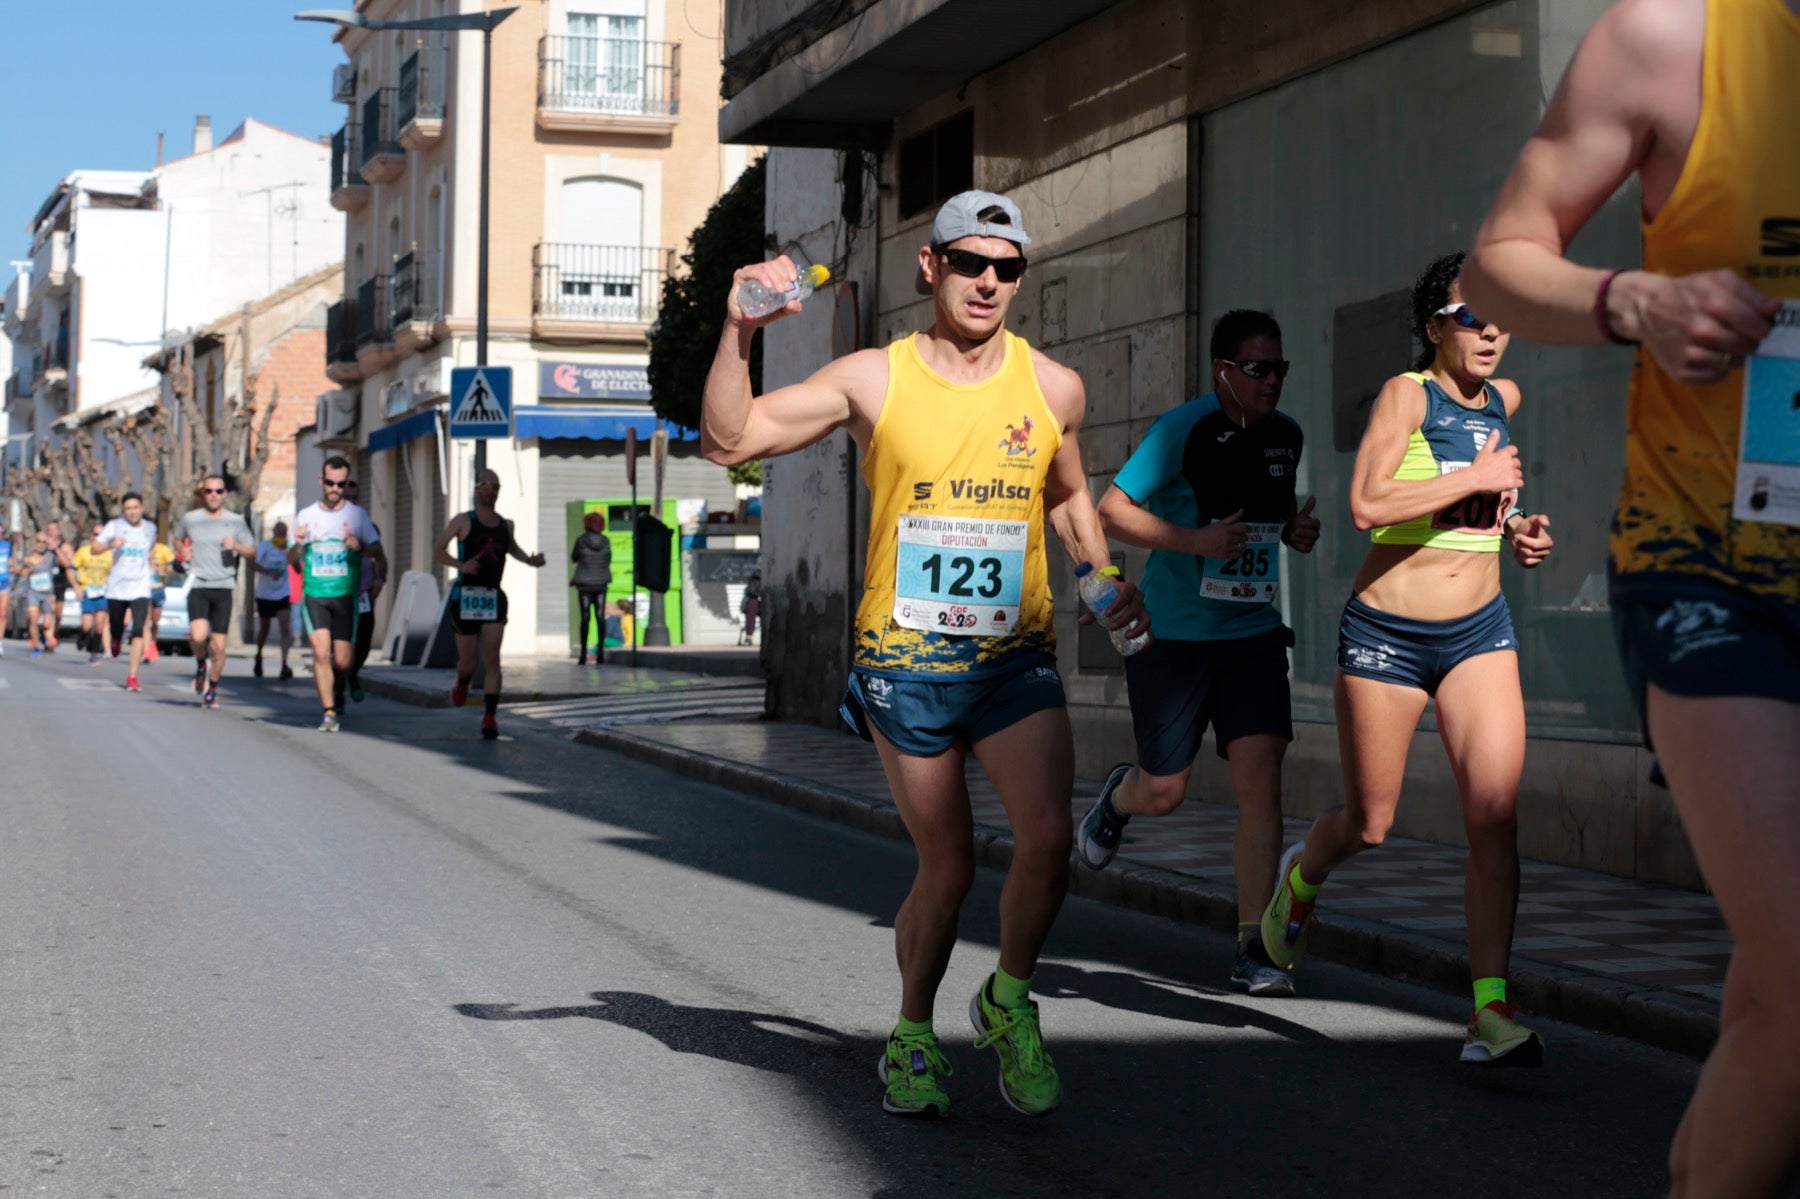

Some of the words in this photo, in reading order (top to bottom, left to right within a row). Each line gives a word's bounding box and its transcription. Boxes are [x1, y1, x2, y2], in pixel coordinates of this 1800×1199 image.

[592, 380, 607, 390] DE
[950, 478, 1031, 504] Vigilsa
[931, 520, 953, 532] GRAN
[955, 522, 983, 534] PREMIO
[985, 523, 994, 535] DE
[996, 525, 1022, 536] FONDO
[942, 534, 987, 548] DIPUTACIÓN
[1219, 549, 1269, 576] 285
[922, 553, 1003, 598] 123
[463, 597, 495, 610] 1036
